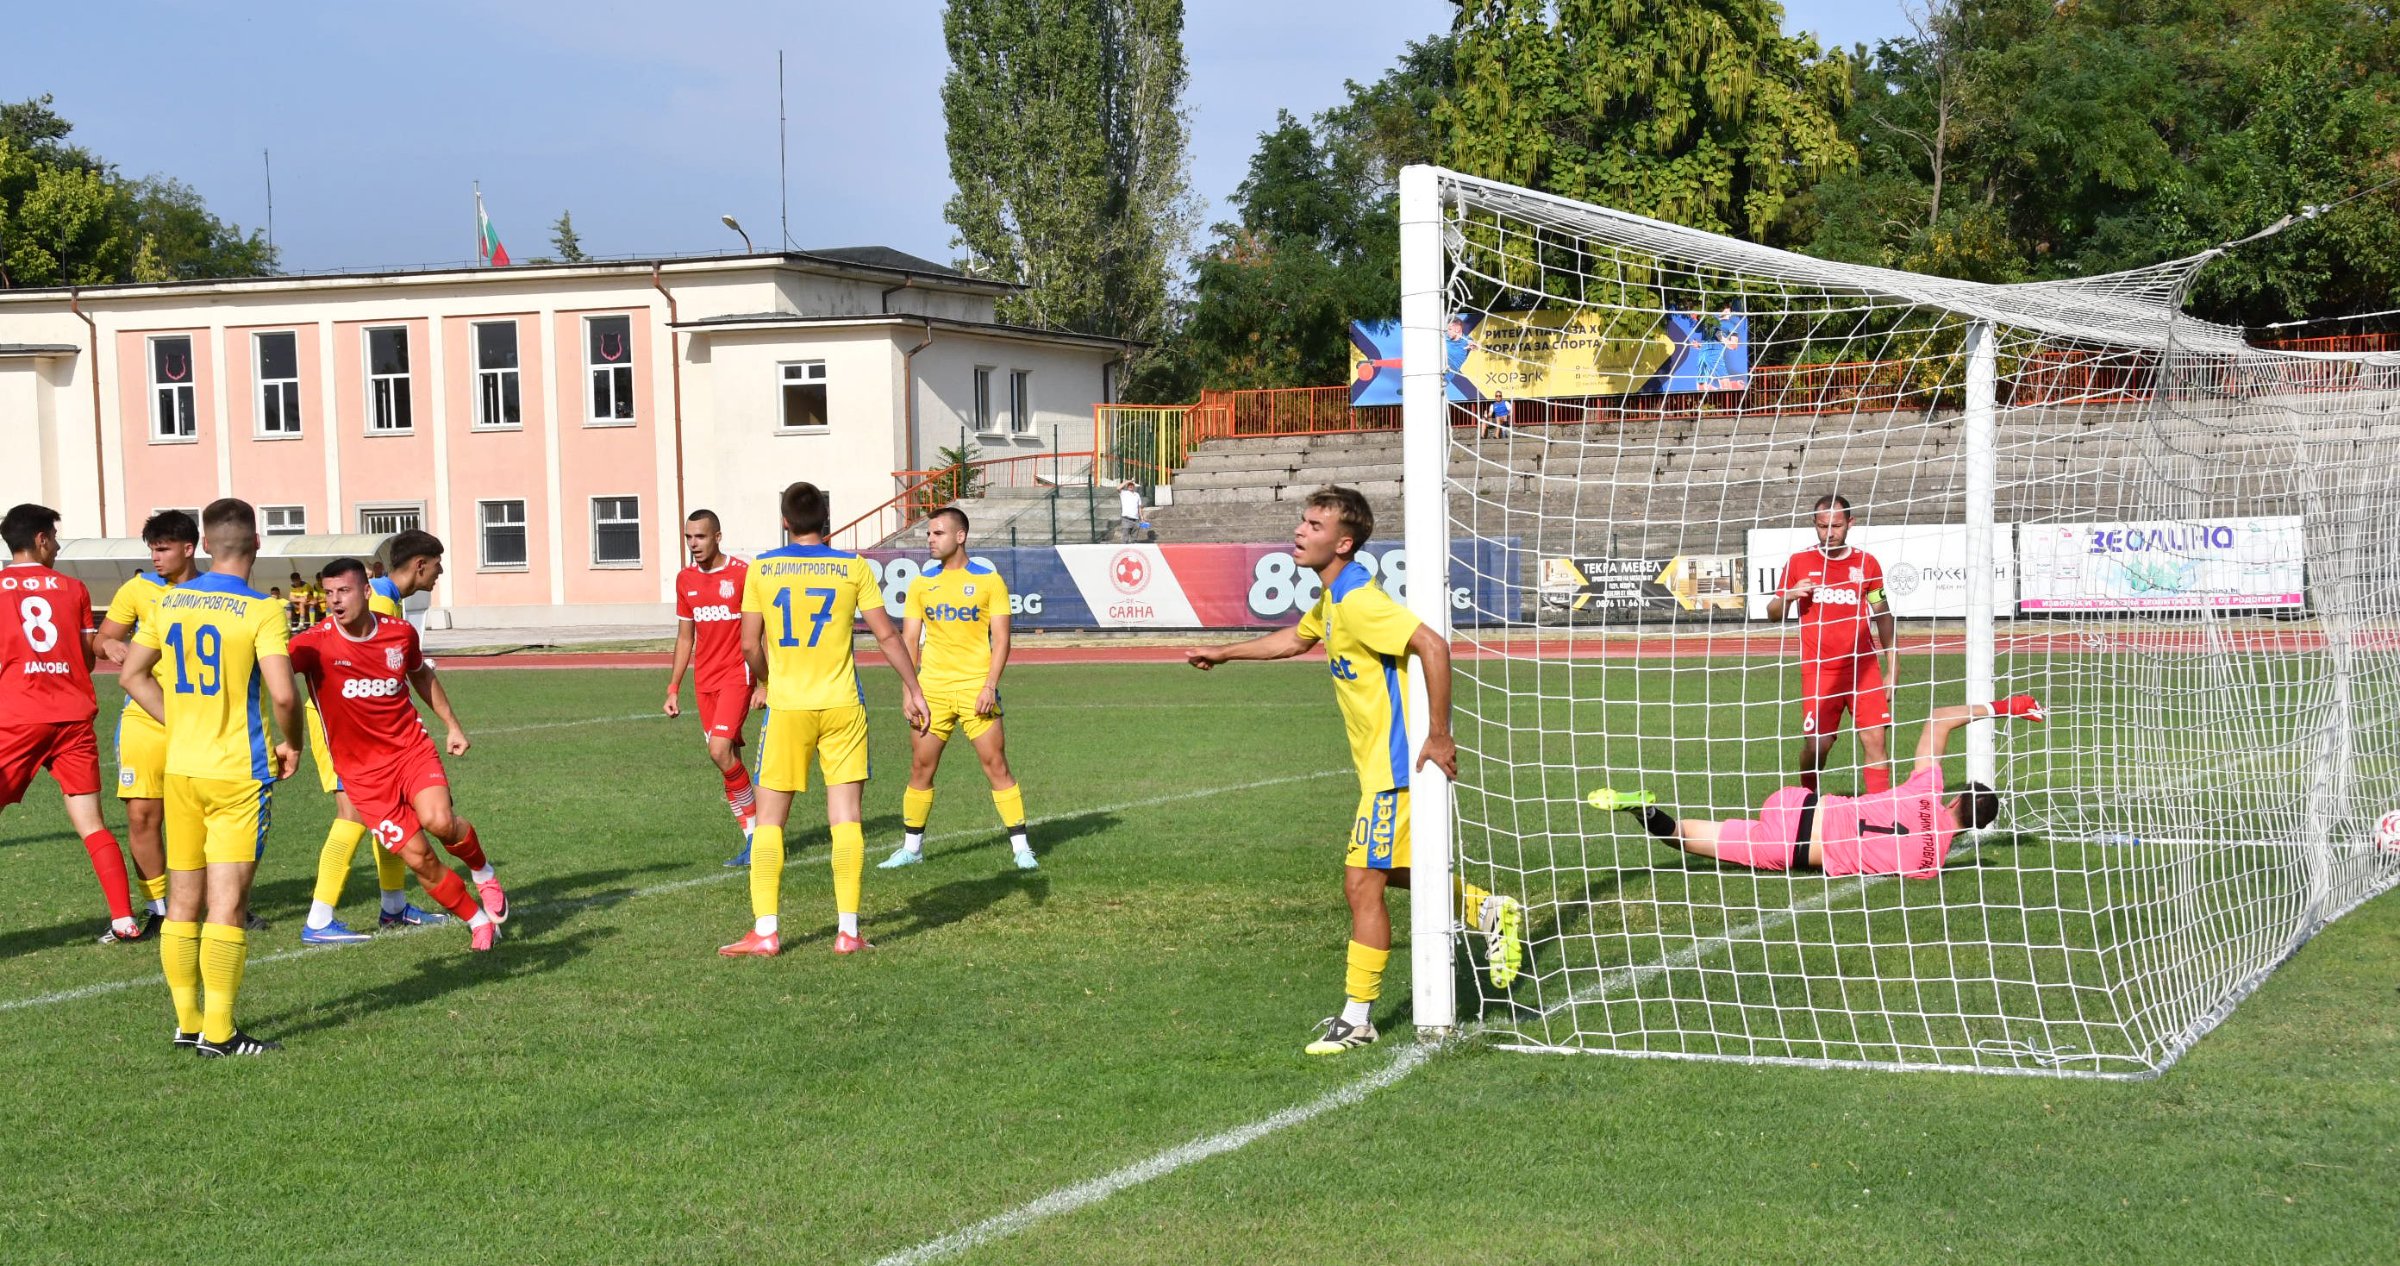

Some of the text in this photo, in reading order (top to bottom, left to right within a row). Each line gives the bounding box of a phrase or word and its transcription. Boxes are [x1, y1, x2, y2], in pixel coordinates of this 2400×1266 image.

[1572, 324, 1587, 335] ЗА
[1485, 339, 1600, 354] ХОРАТА ЗА СПОРТА
[761, 562, 848, 577] ФК ДИМИТРОВГРАД
[1583, 561, 1661, 574] ТЕКРА МЕБЕЛ
[172, 594, 247, 618] ДИМИТРОВГРАД
[2233, 595, 2282, 604] РОДОПИТЕ
[772, 587, 836, 648] 17
[925, 603, 980, 621] efbet
[1109, 606, 1154, 618] САЯНА
[21, 596, 58, 653] 8
[165, 623, 221, 696] 19
[1803, 711, 1815, 732] 6
[371, 819, 404, 850] 23
[1373, 794, 1393, 860] efbet
[1859, 818, 1910, 837] 1
